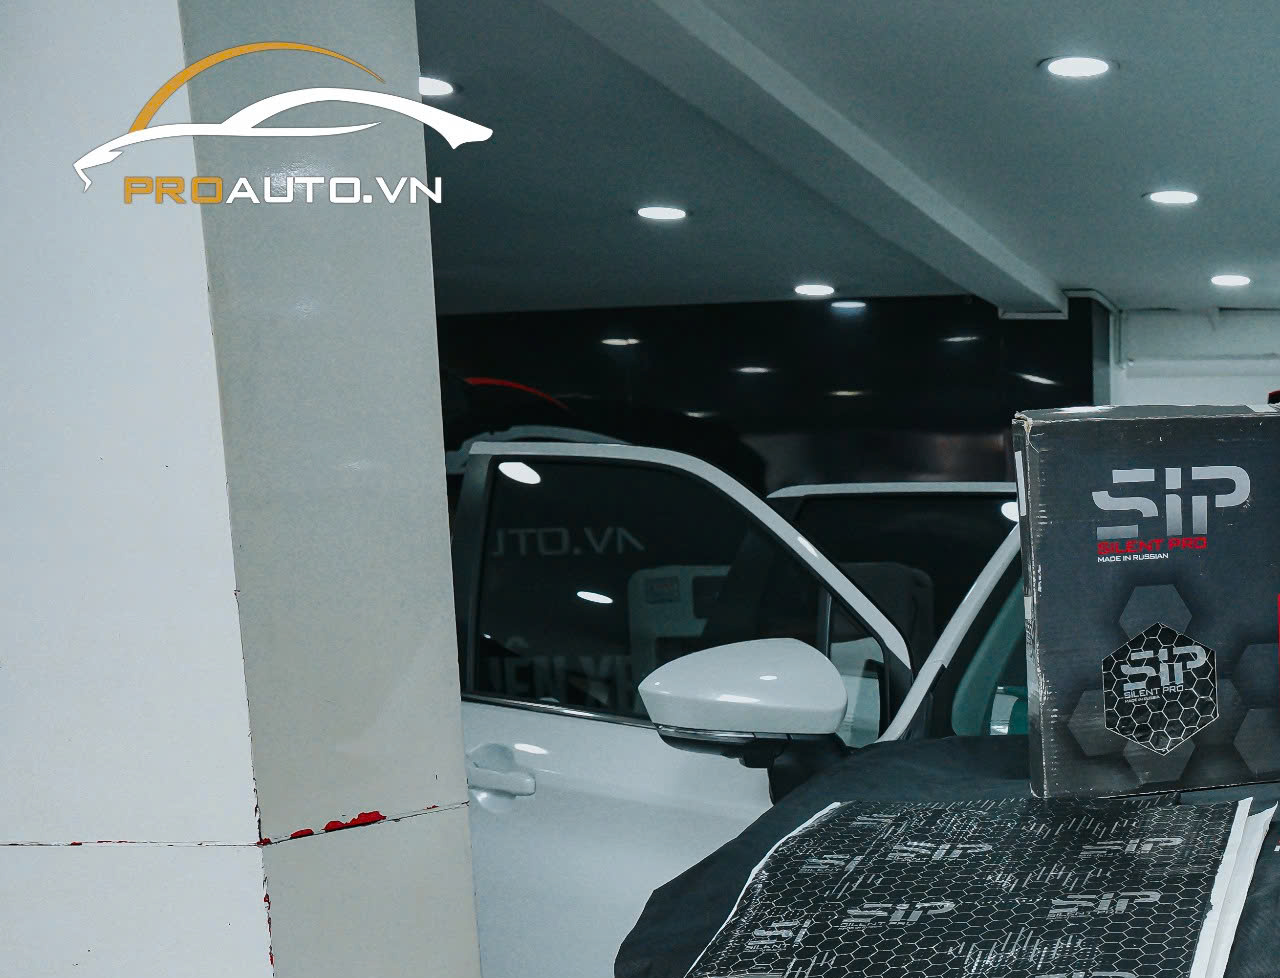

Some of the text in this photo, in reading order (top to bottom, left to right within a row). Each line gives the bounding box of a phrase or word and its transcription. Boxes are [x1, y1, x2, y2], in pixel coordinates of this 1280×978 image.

[1097, 537, 1207, 555] SILENT PRO
[1133, 553, 1169, 561] RUSSIAN
[1124, 685, 1183, 698] SILENT PRO
